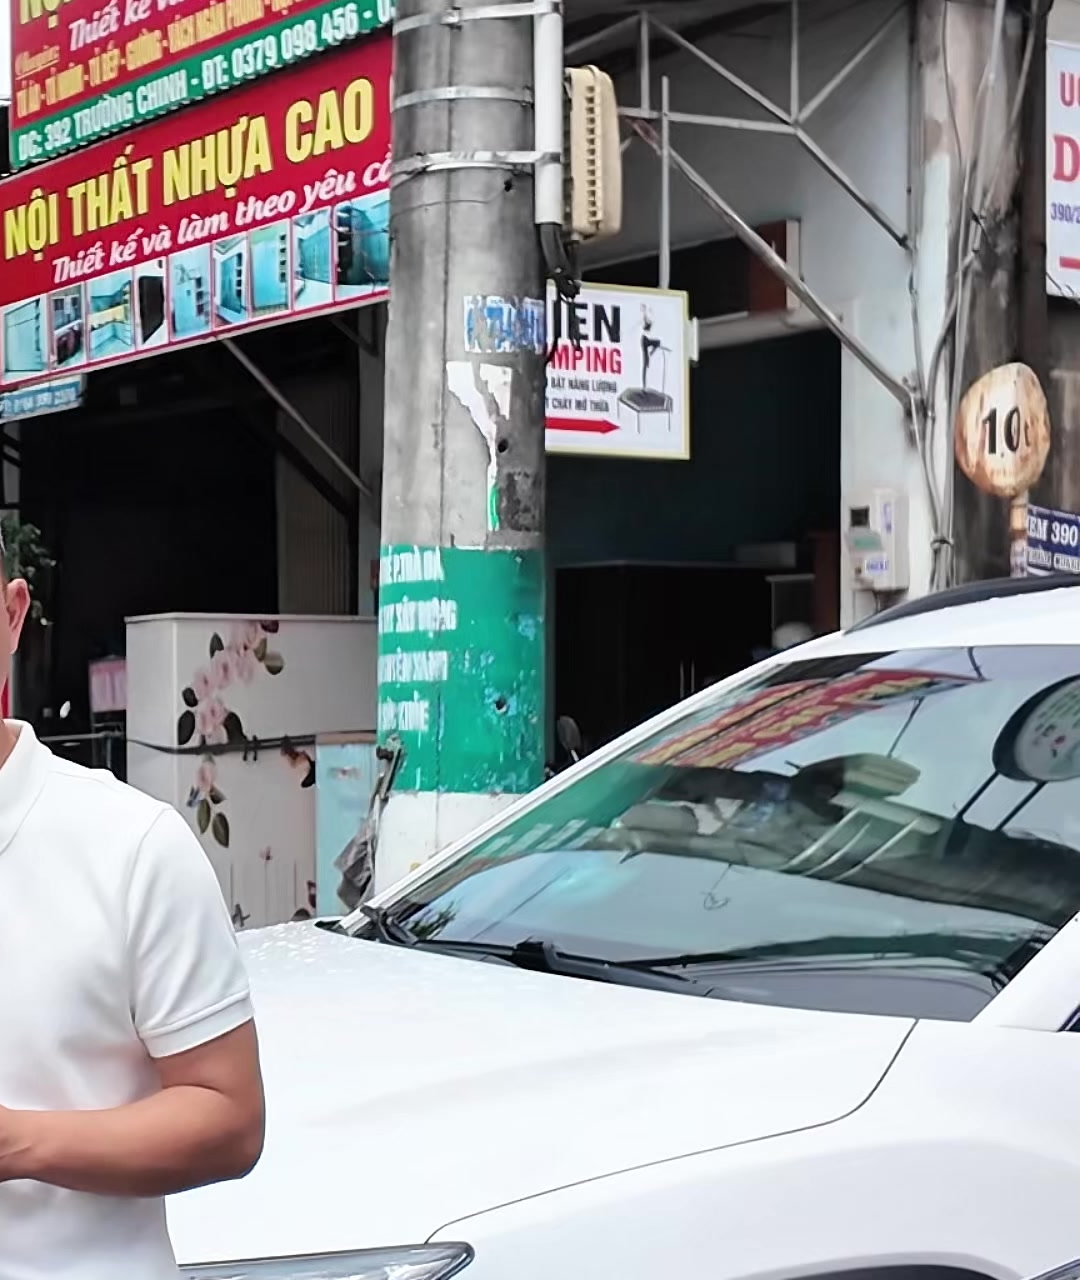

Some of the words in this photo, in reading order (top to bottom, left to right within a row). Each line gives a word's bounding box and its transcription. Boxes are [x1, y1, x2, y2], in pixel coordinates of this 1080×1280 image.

[69, 0, 120, 51] Thiết
[44, 117, 72, 150] 392
[73, 94, 134, 139] TRƯỜNG
[136, 69, 188, 114] CHINH
[231, 36, 277, 78] 0379
[281, 20, 317, 59] 098
[321, 2, 359, 43] 456
[1059, 71, 1080, 107] U
[4, 187, 59, 263] NỘI
[67, 144, 152, 236] THẤT
[163, 115, 273, 206] NHỰA
[285, 78, 374, 163] CAO
[52, 241, 104, 285] Thiết
[110, 229, 144, 262] kế
[141, 224, 172, 257] và
[177, 209, 229, 244] làm
[235, 190, 296, 225] theo
[299, 167, 356, 212] yêu
[551, 344, 622, 375] MPING
[1051, 521, 1078, 547] 390
